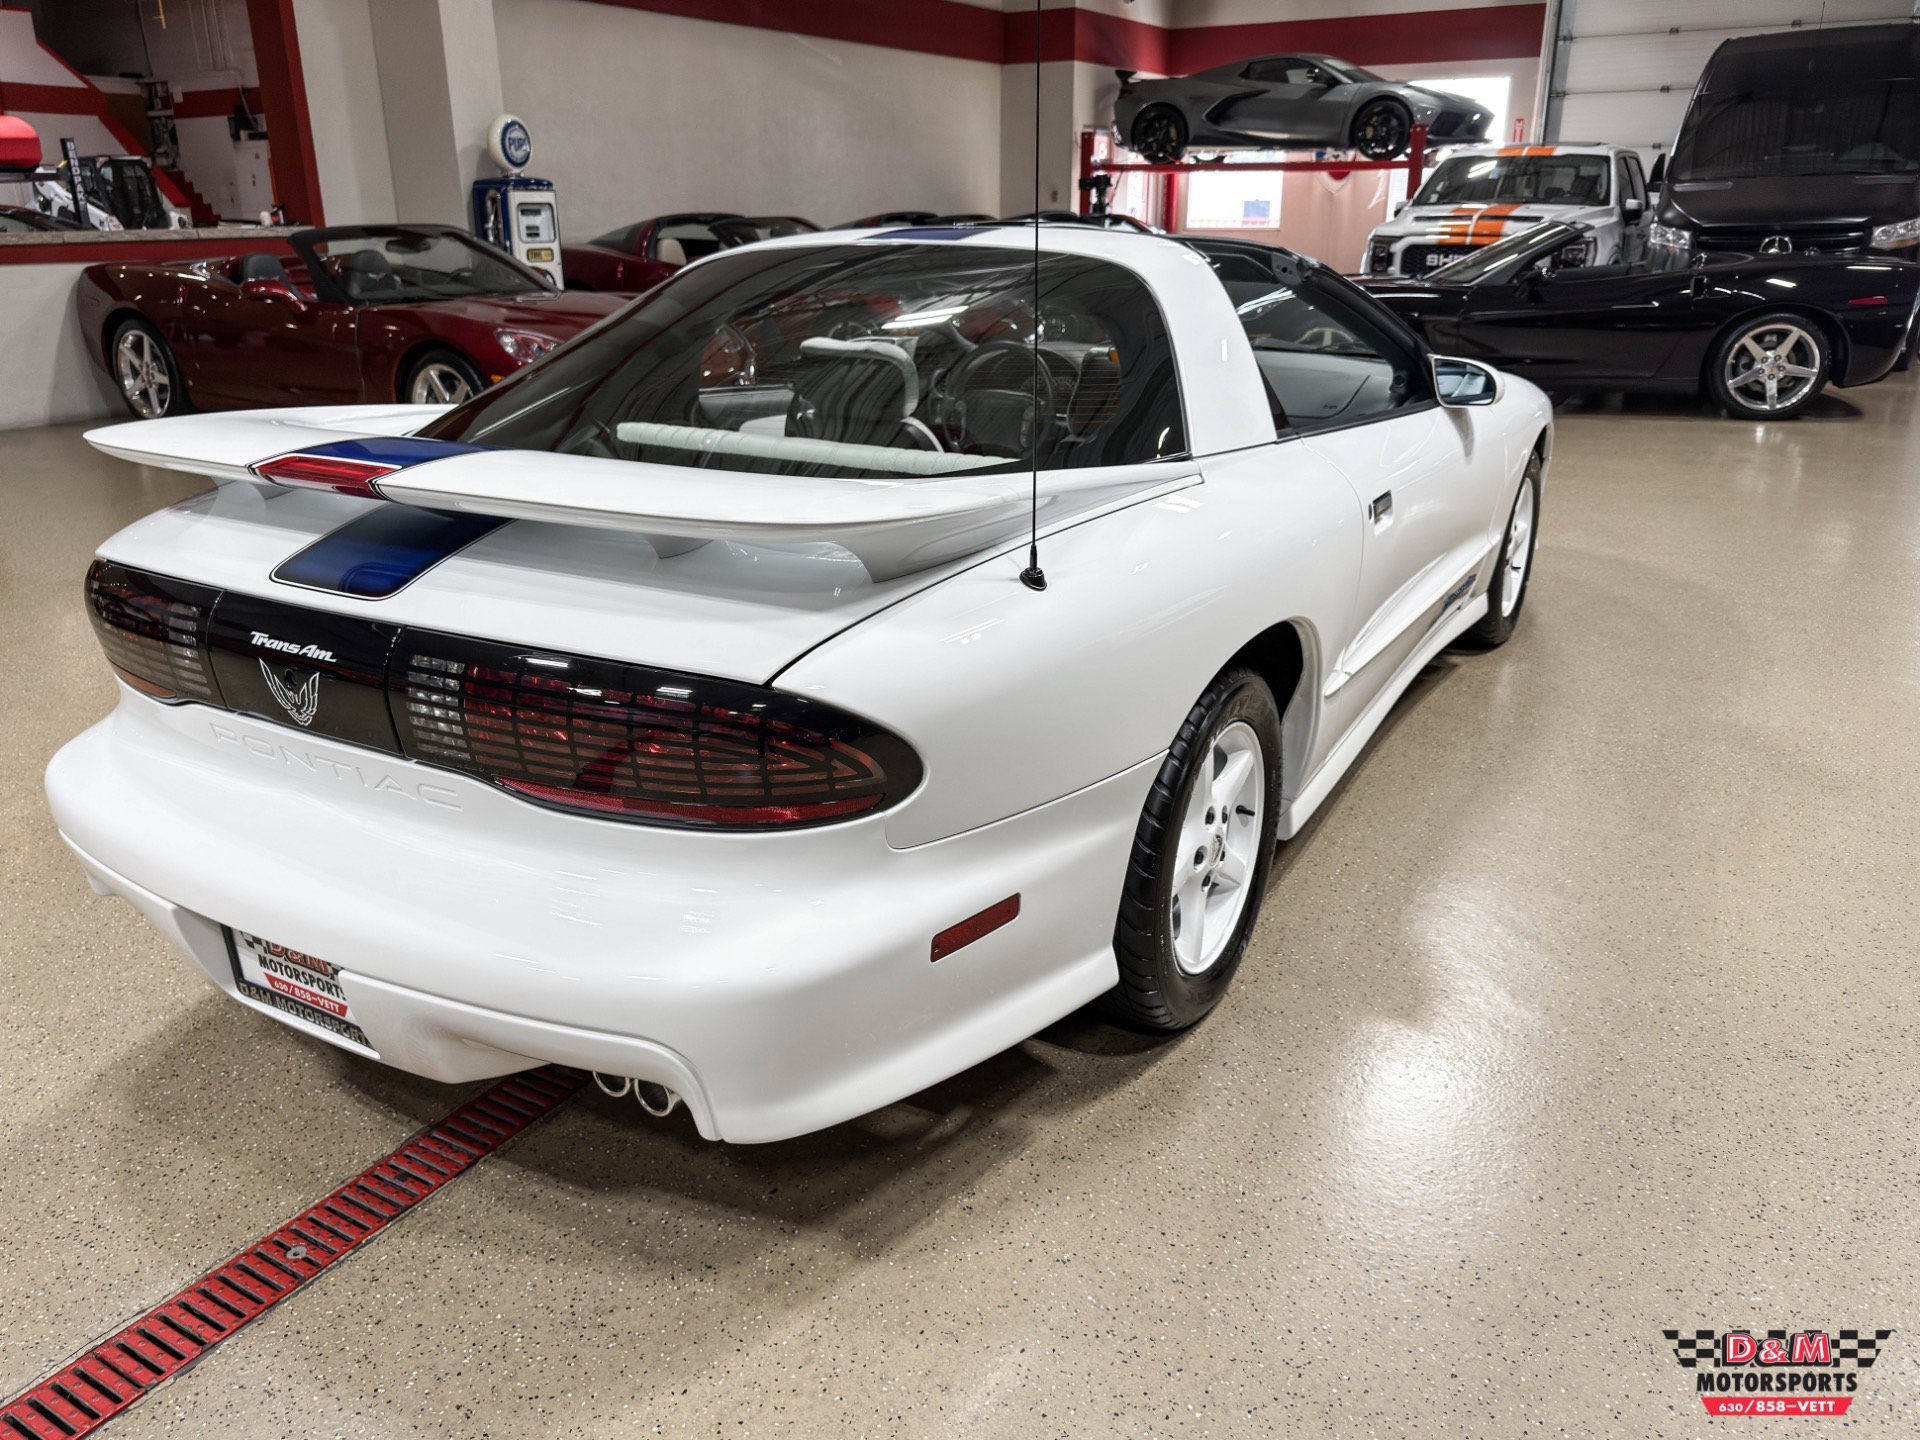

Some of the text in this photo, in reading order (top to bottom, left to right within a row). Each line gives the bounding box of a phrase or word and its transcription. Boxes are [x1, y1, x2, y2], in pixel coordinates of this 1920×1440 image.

[250, 630, 338, 663] Trans Am
[208, 722, 464, 812] PONTIAC
